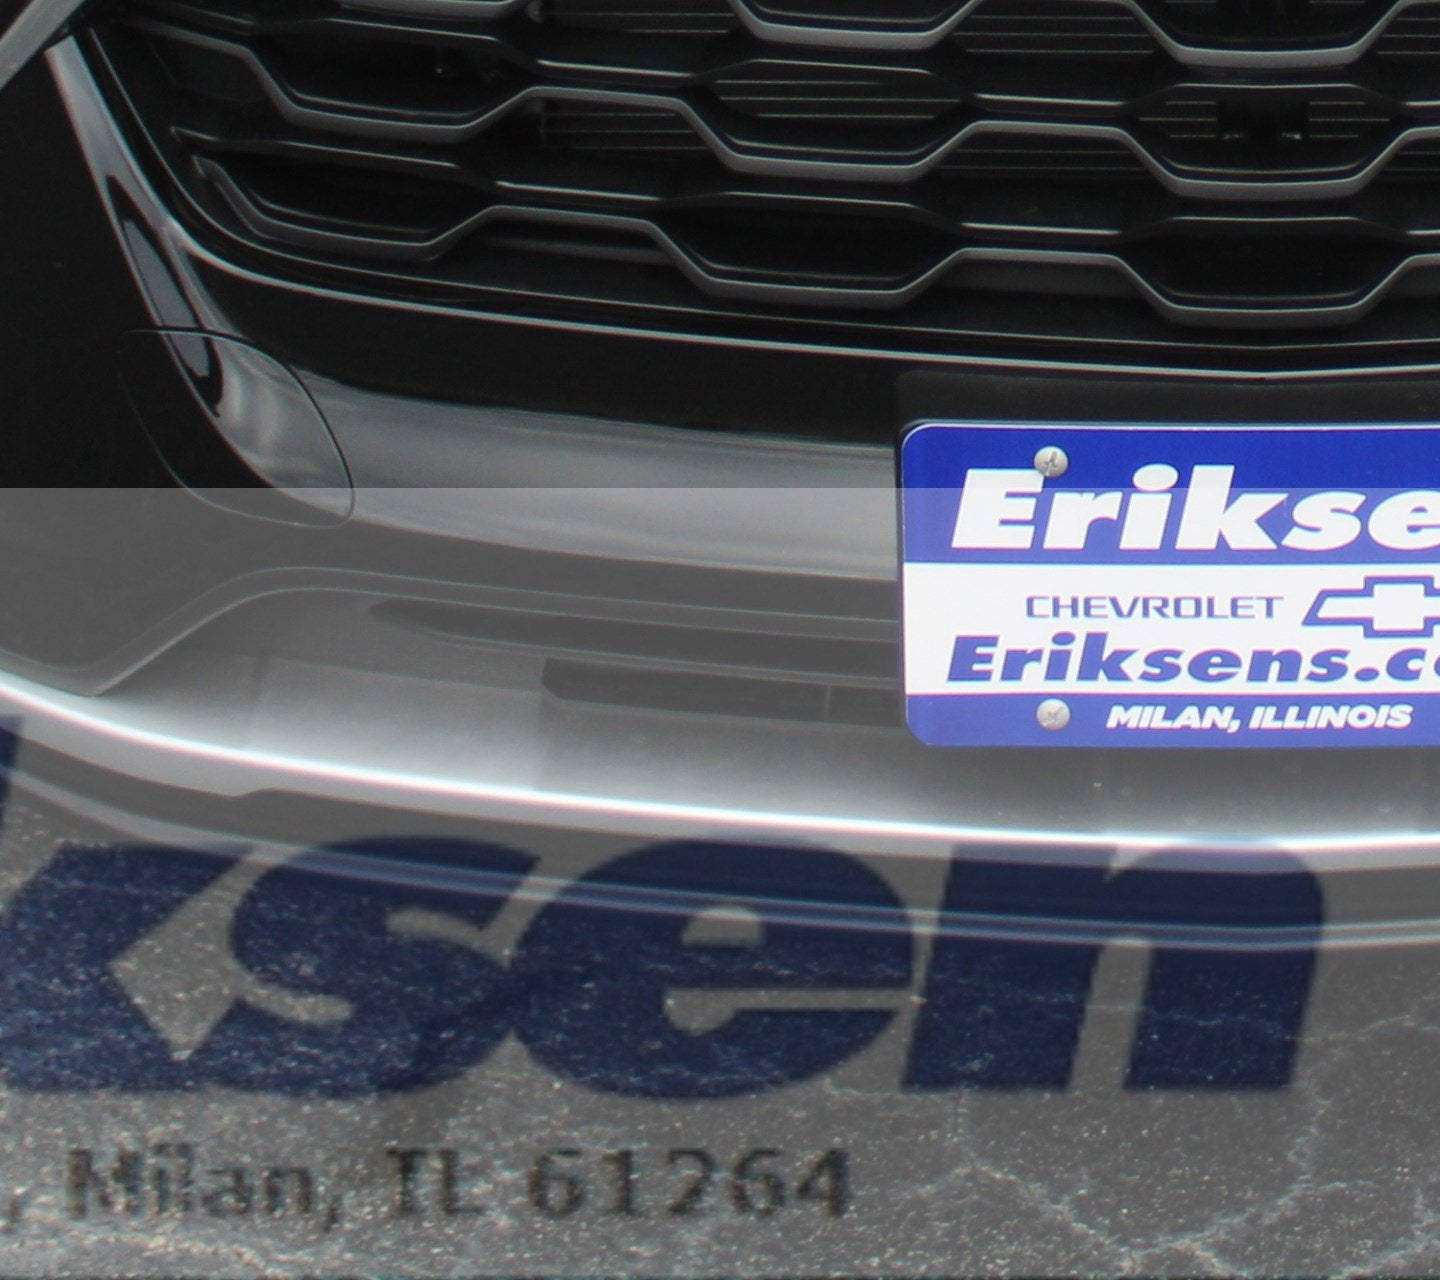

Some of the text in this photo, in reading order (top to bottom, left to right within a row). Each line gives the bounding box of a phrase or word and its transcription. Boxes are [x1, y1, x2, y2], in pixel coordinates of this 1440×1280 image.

[1025, 594, 1285, 620] CHEVROLET
[1106, 704, 1414, 733] MILAN, ILLINOIS
